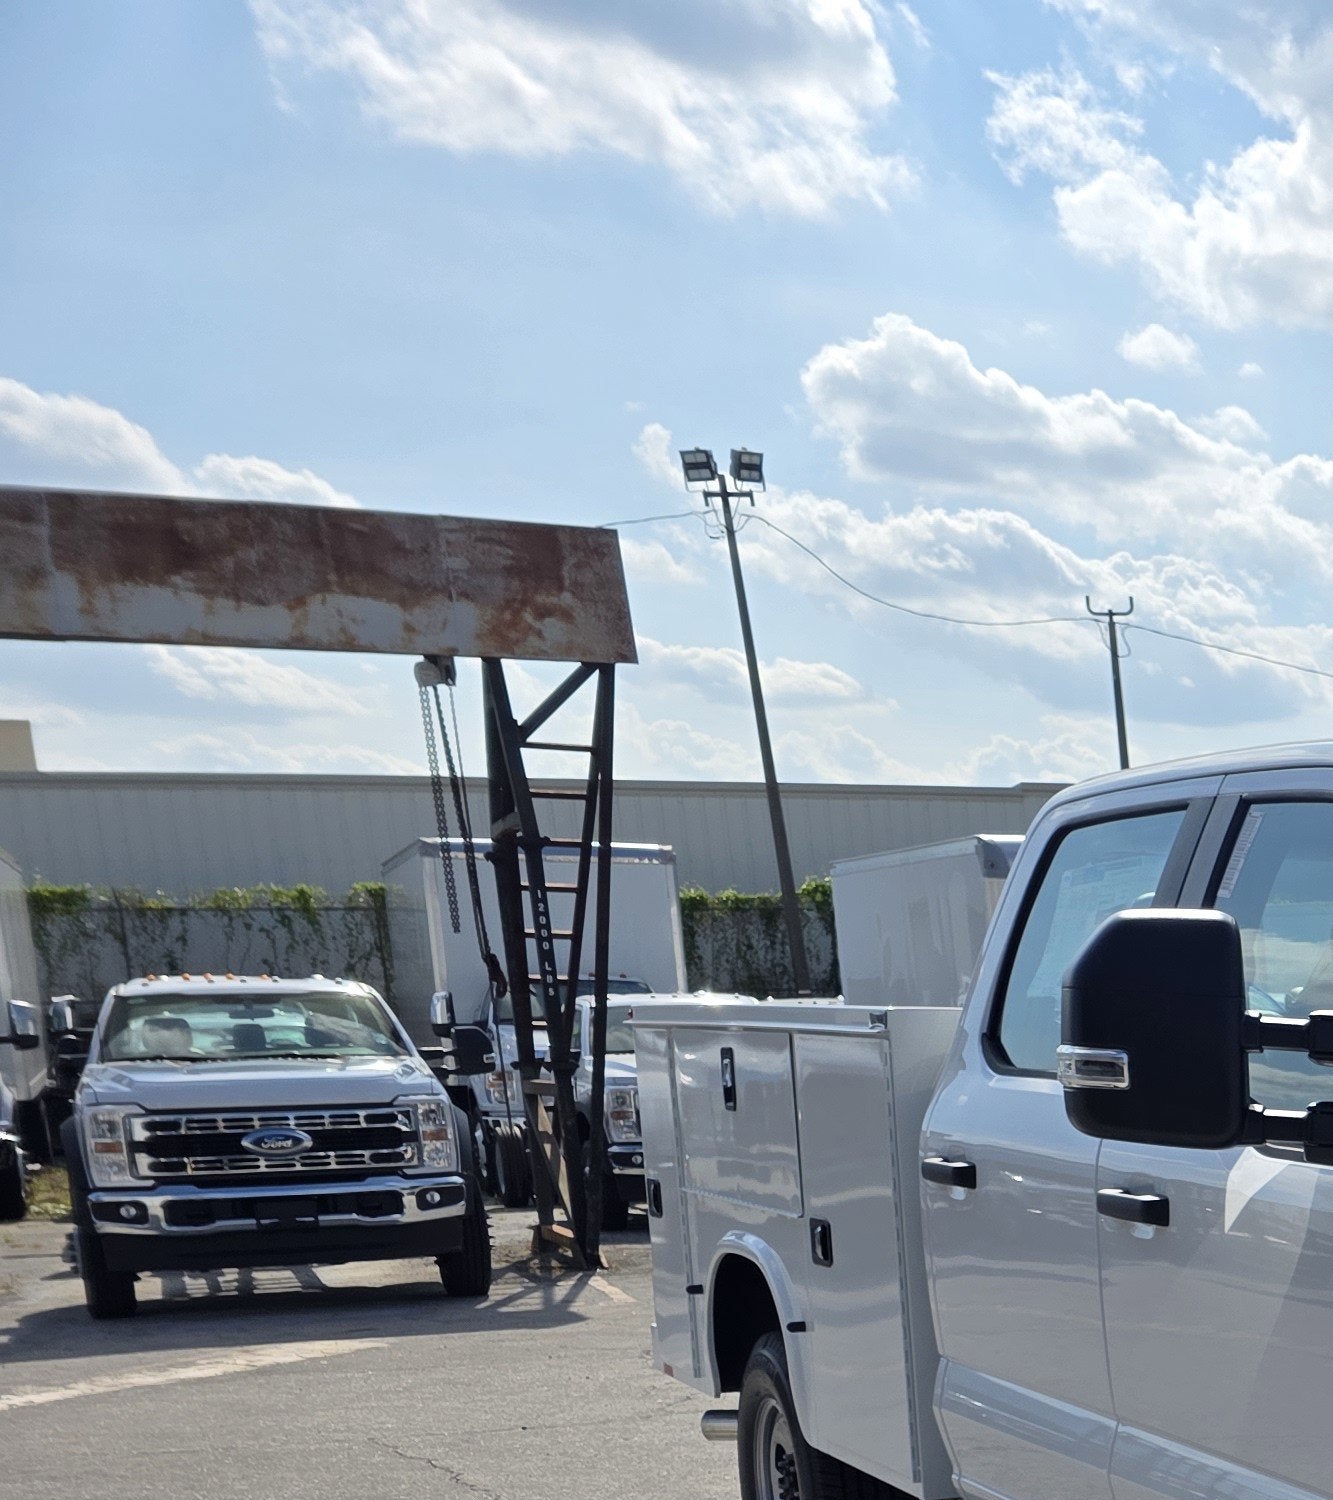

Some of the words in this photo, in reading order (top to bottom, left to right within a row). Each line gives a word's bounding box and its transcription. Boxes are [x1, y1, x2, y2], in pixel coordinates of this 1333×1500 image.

[537, 889, 549, 950] 12000
[545, 961, 555, 996] LBS
[261, 1136, 293, 1149] Ford
